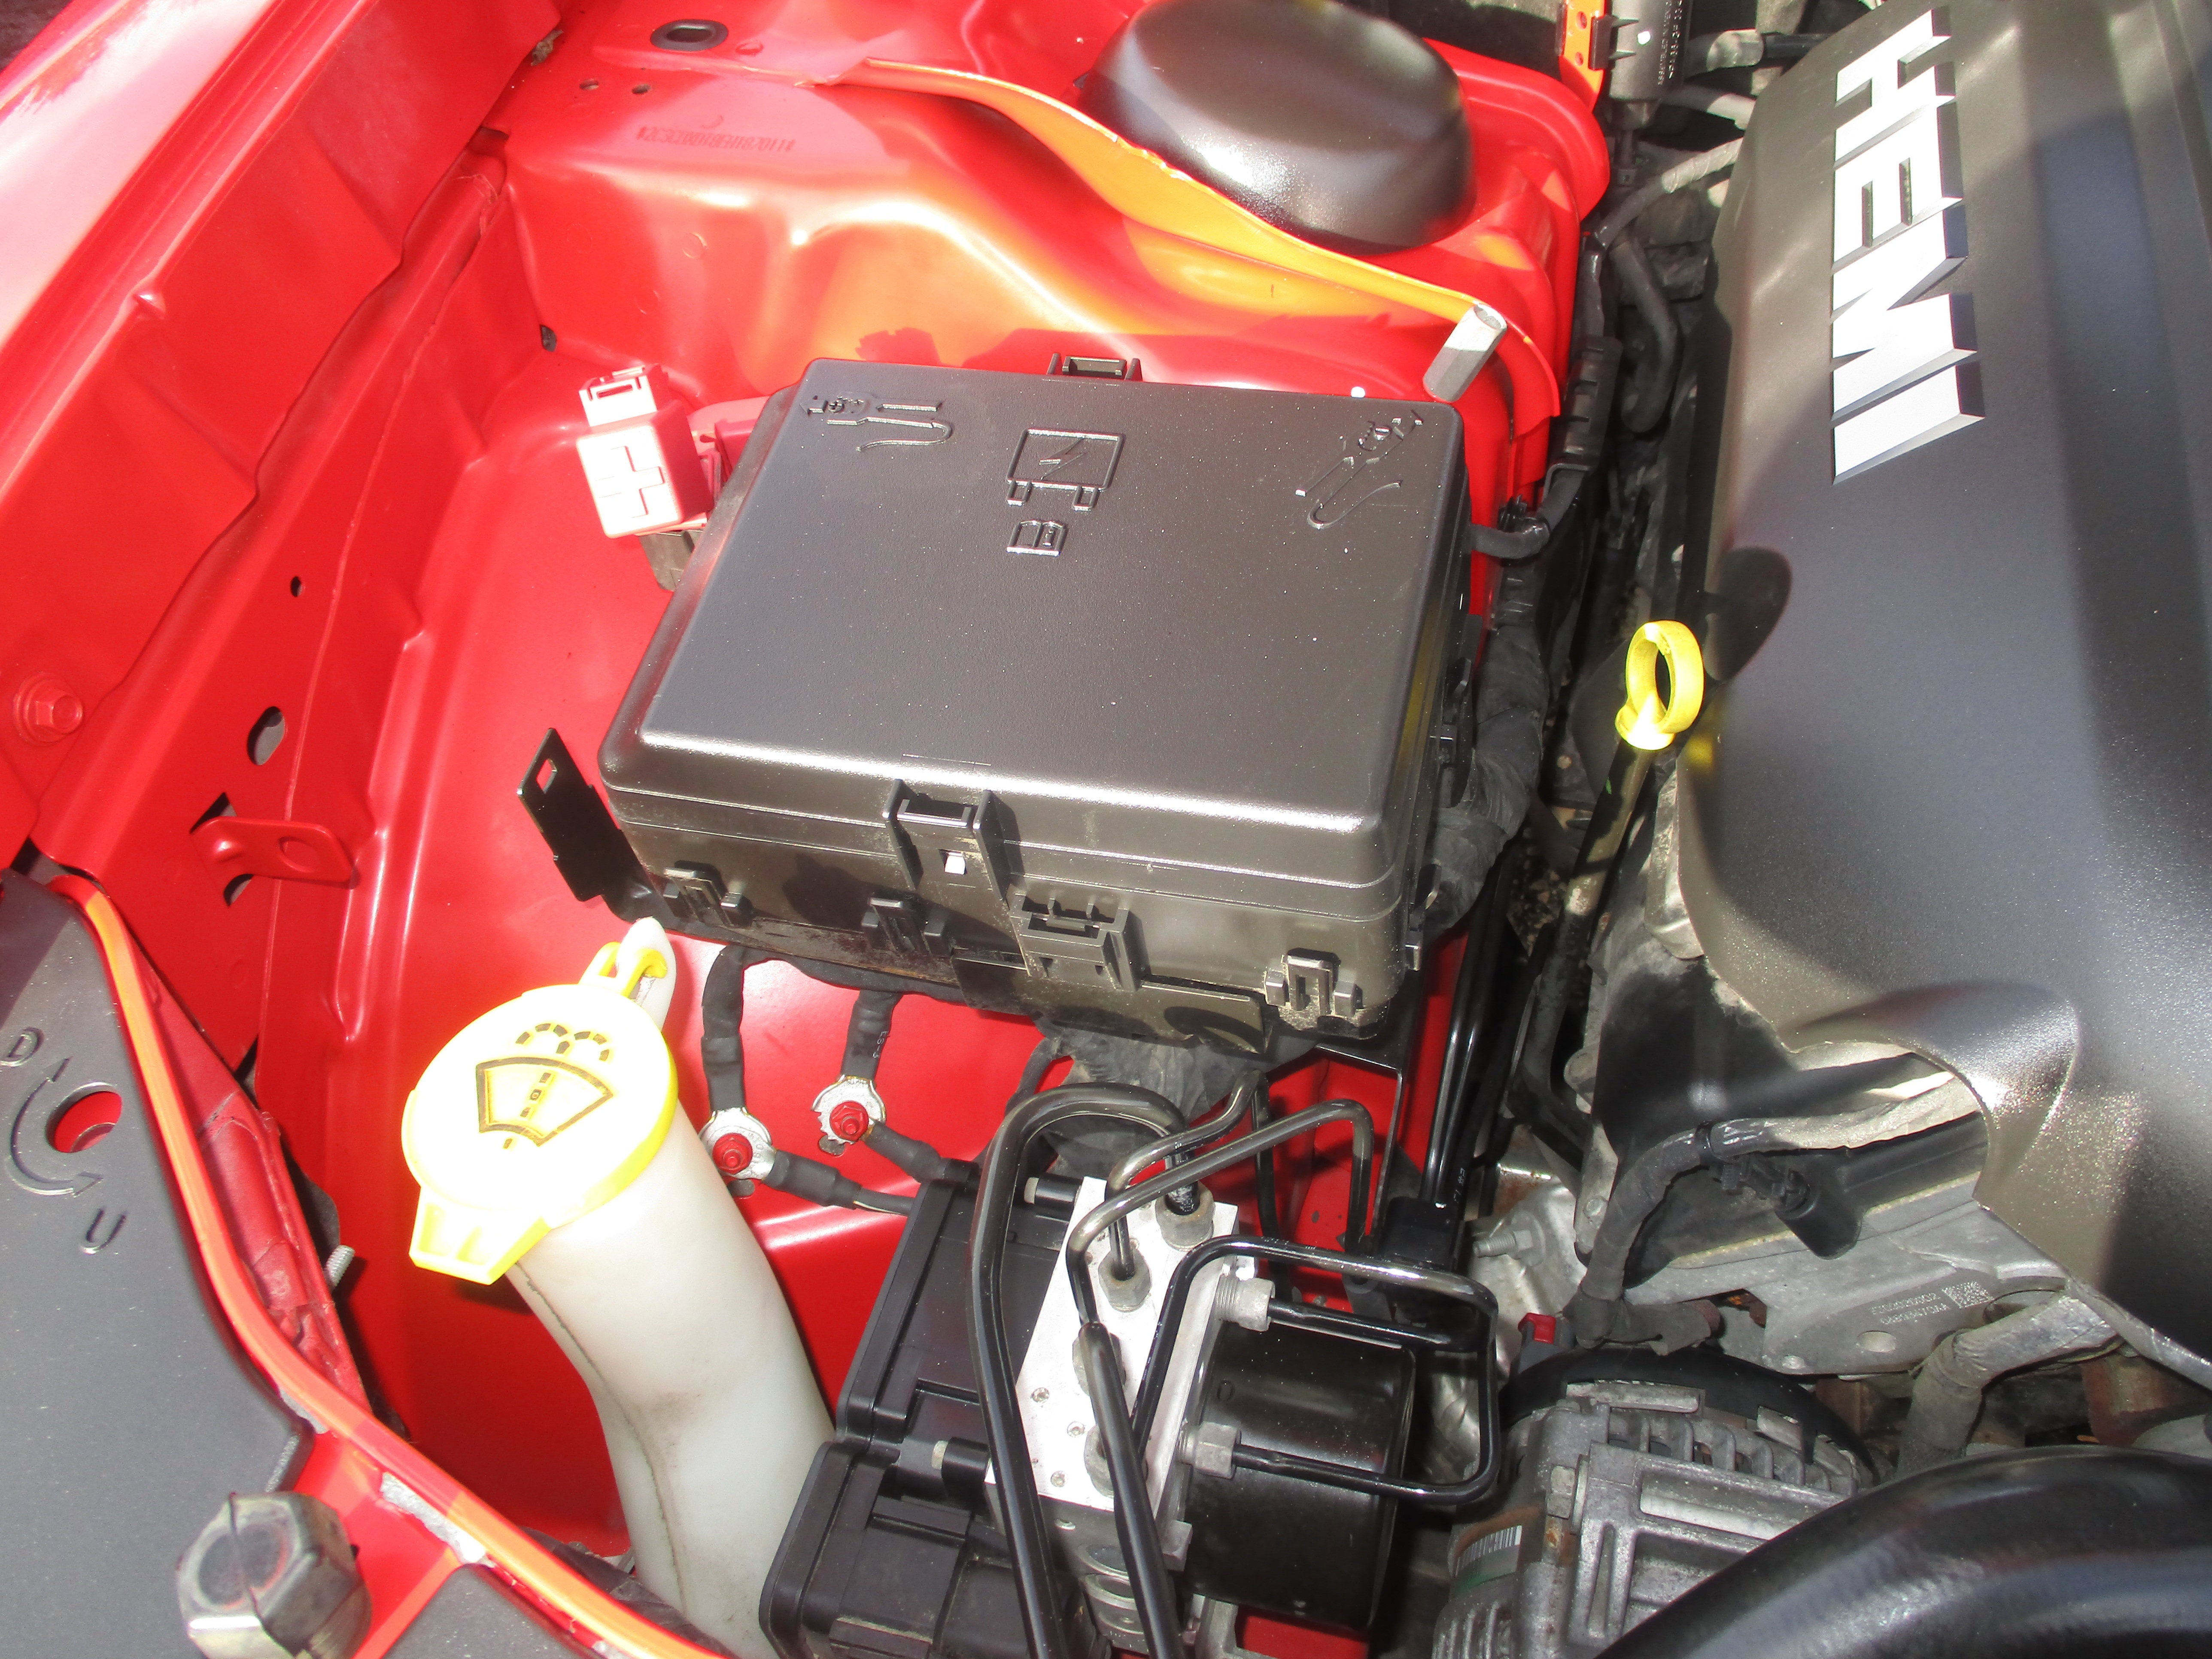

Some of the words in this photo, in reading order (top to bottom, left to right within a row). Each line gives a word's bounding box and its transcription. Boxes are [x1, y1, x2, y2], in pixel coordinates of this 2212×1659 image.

[1832, 9, 1984, 485] HEMI
[0, 1027, 44, 1067] D
[79, 1206, 127, 1255] U
